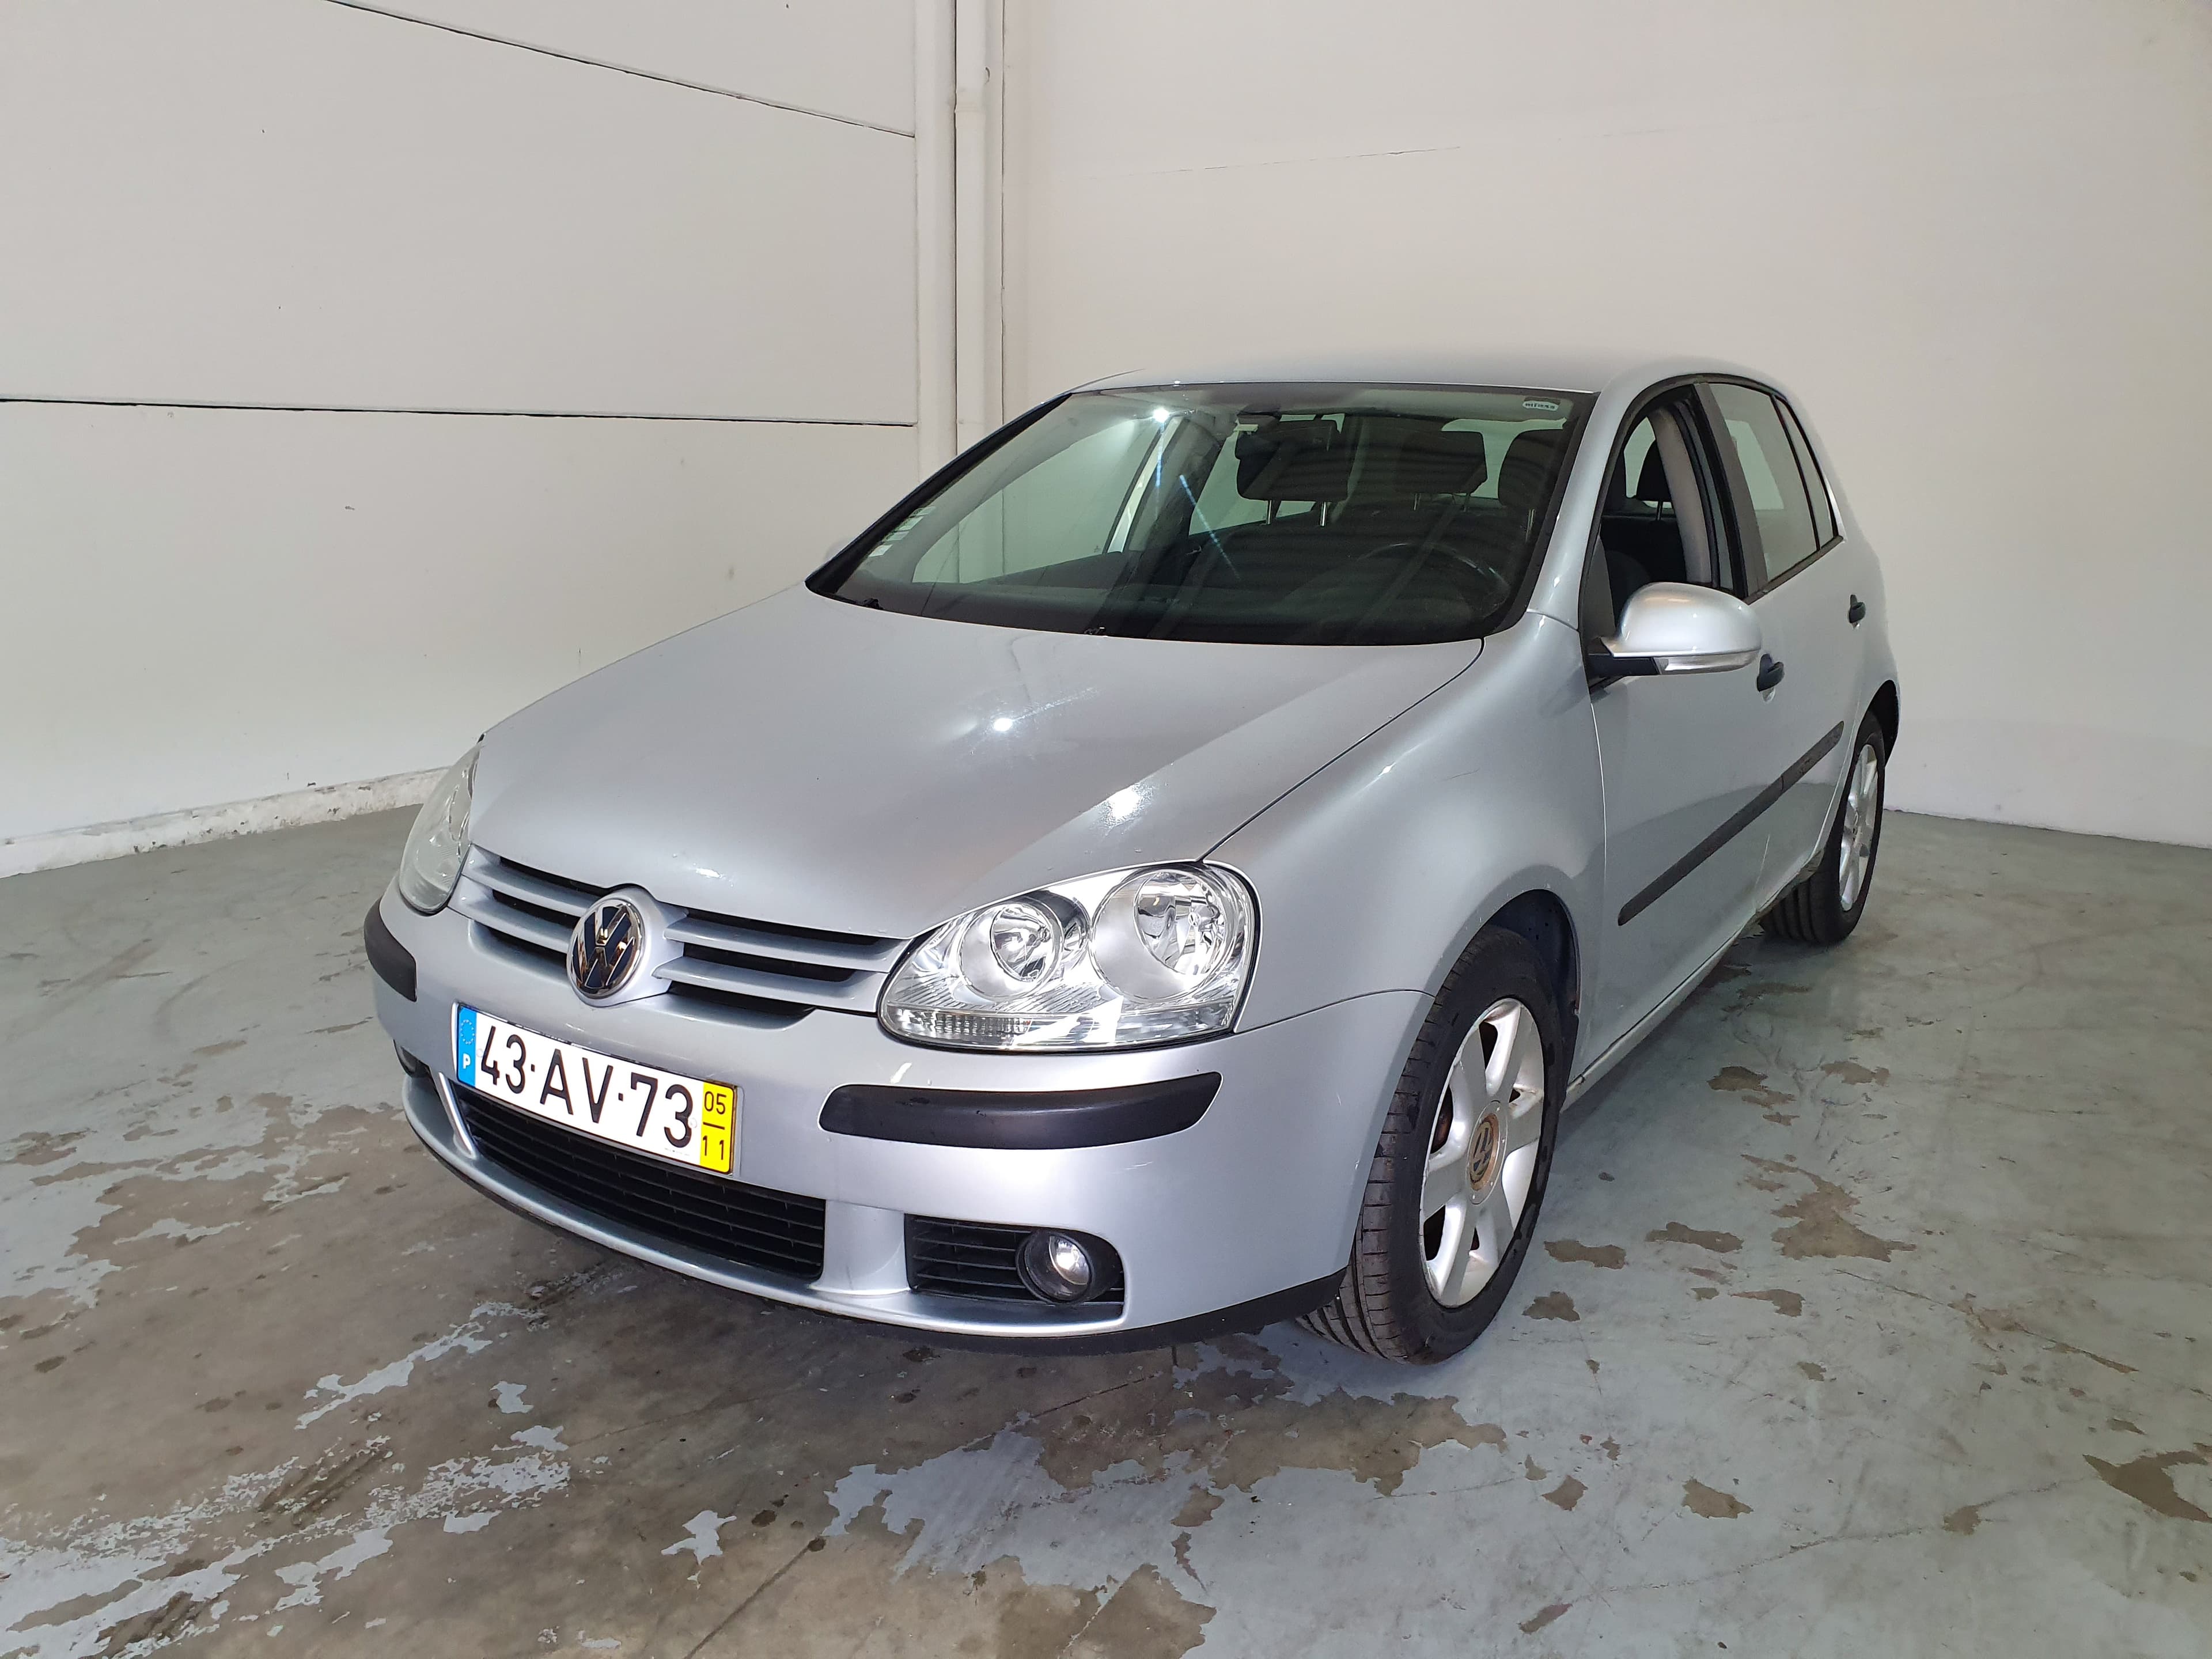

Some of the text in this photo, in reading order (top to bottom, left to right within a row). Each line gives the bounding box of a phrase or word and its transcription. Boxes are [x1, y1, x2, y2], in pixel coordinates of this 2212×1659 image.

[570, 902, 641, 995] VW
[463, 1052, 471, 1069] P
[704, 1090, 726, 1115] 05
[702, 1135, 725, 1160] 11
